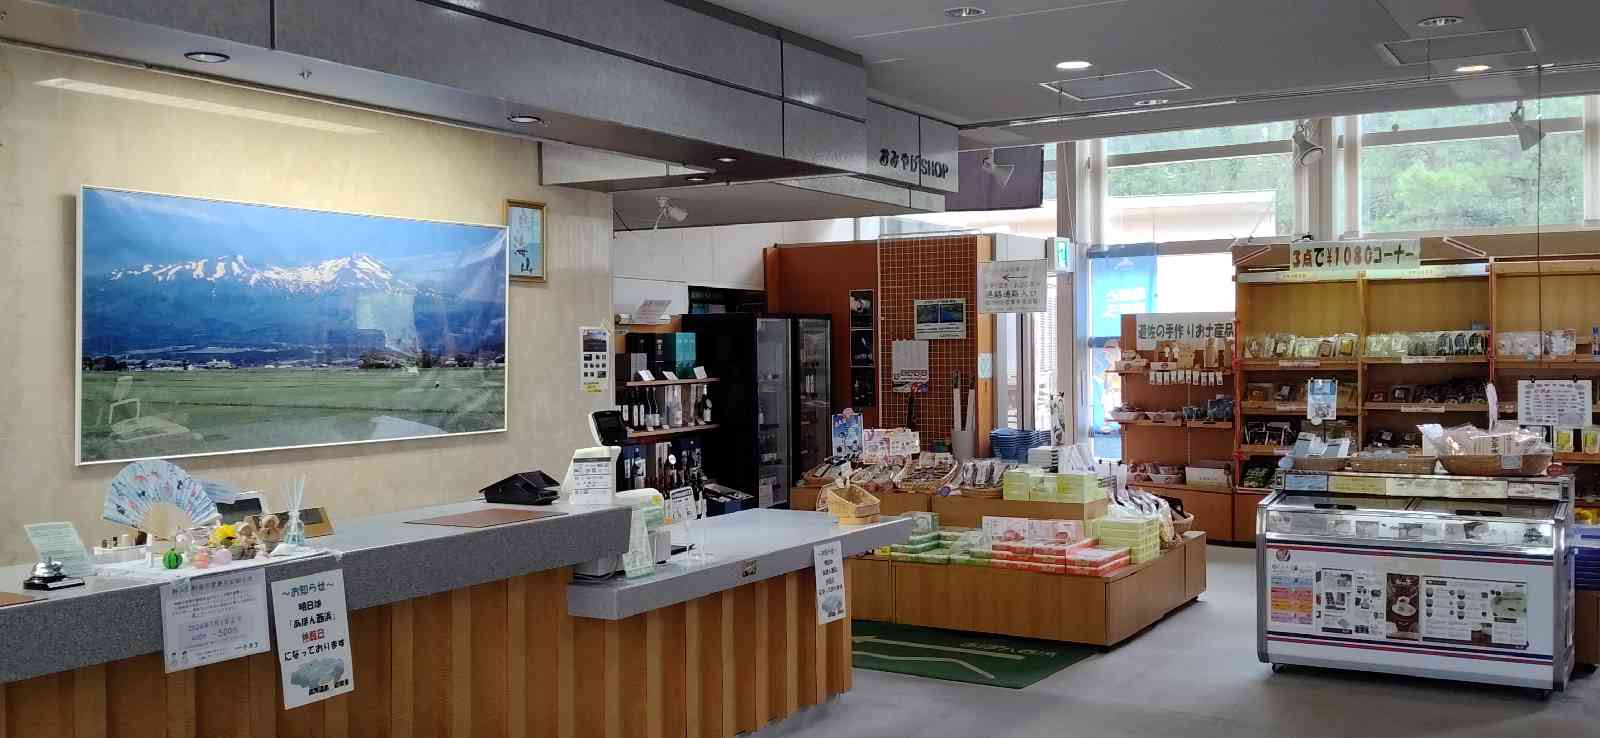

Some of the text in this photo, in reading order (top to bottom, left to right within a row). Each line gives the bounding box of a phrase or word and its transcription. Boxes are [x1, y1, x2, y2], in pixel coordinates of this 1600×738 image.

[921, 159, 949, 179] SHOP
[298, 600, 322, 612] 明日は
[285, 639, 345, 661] になっております
